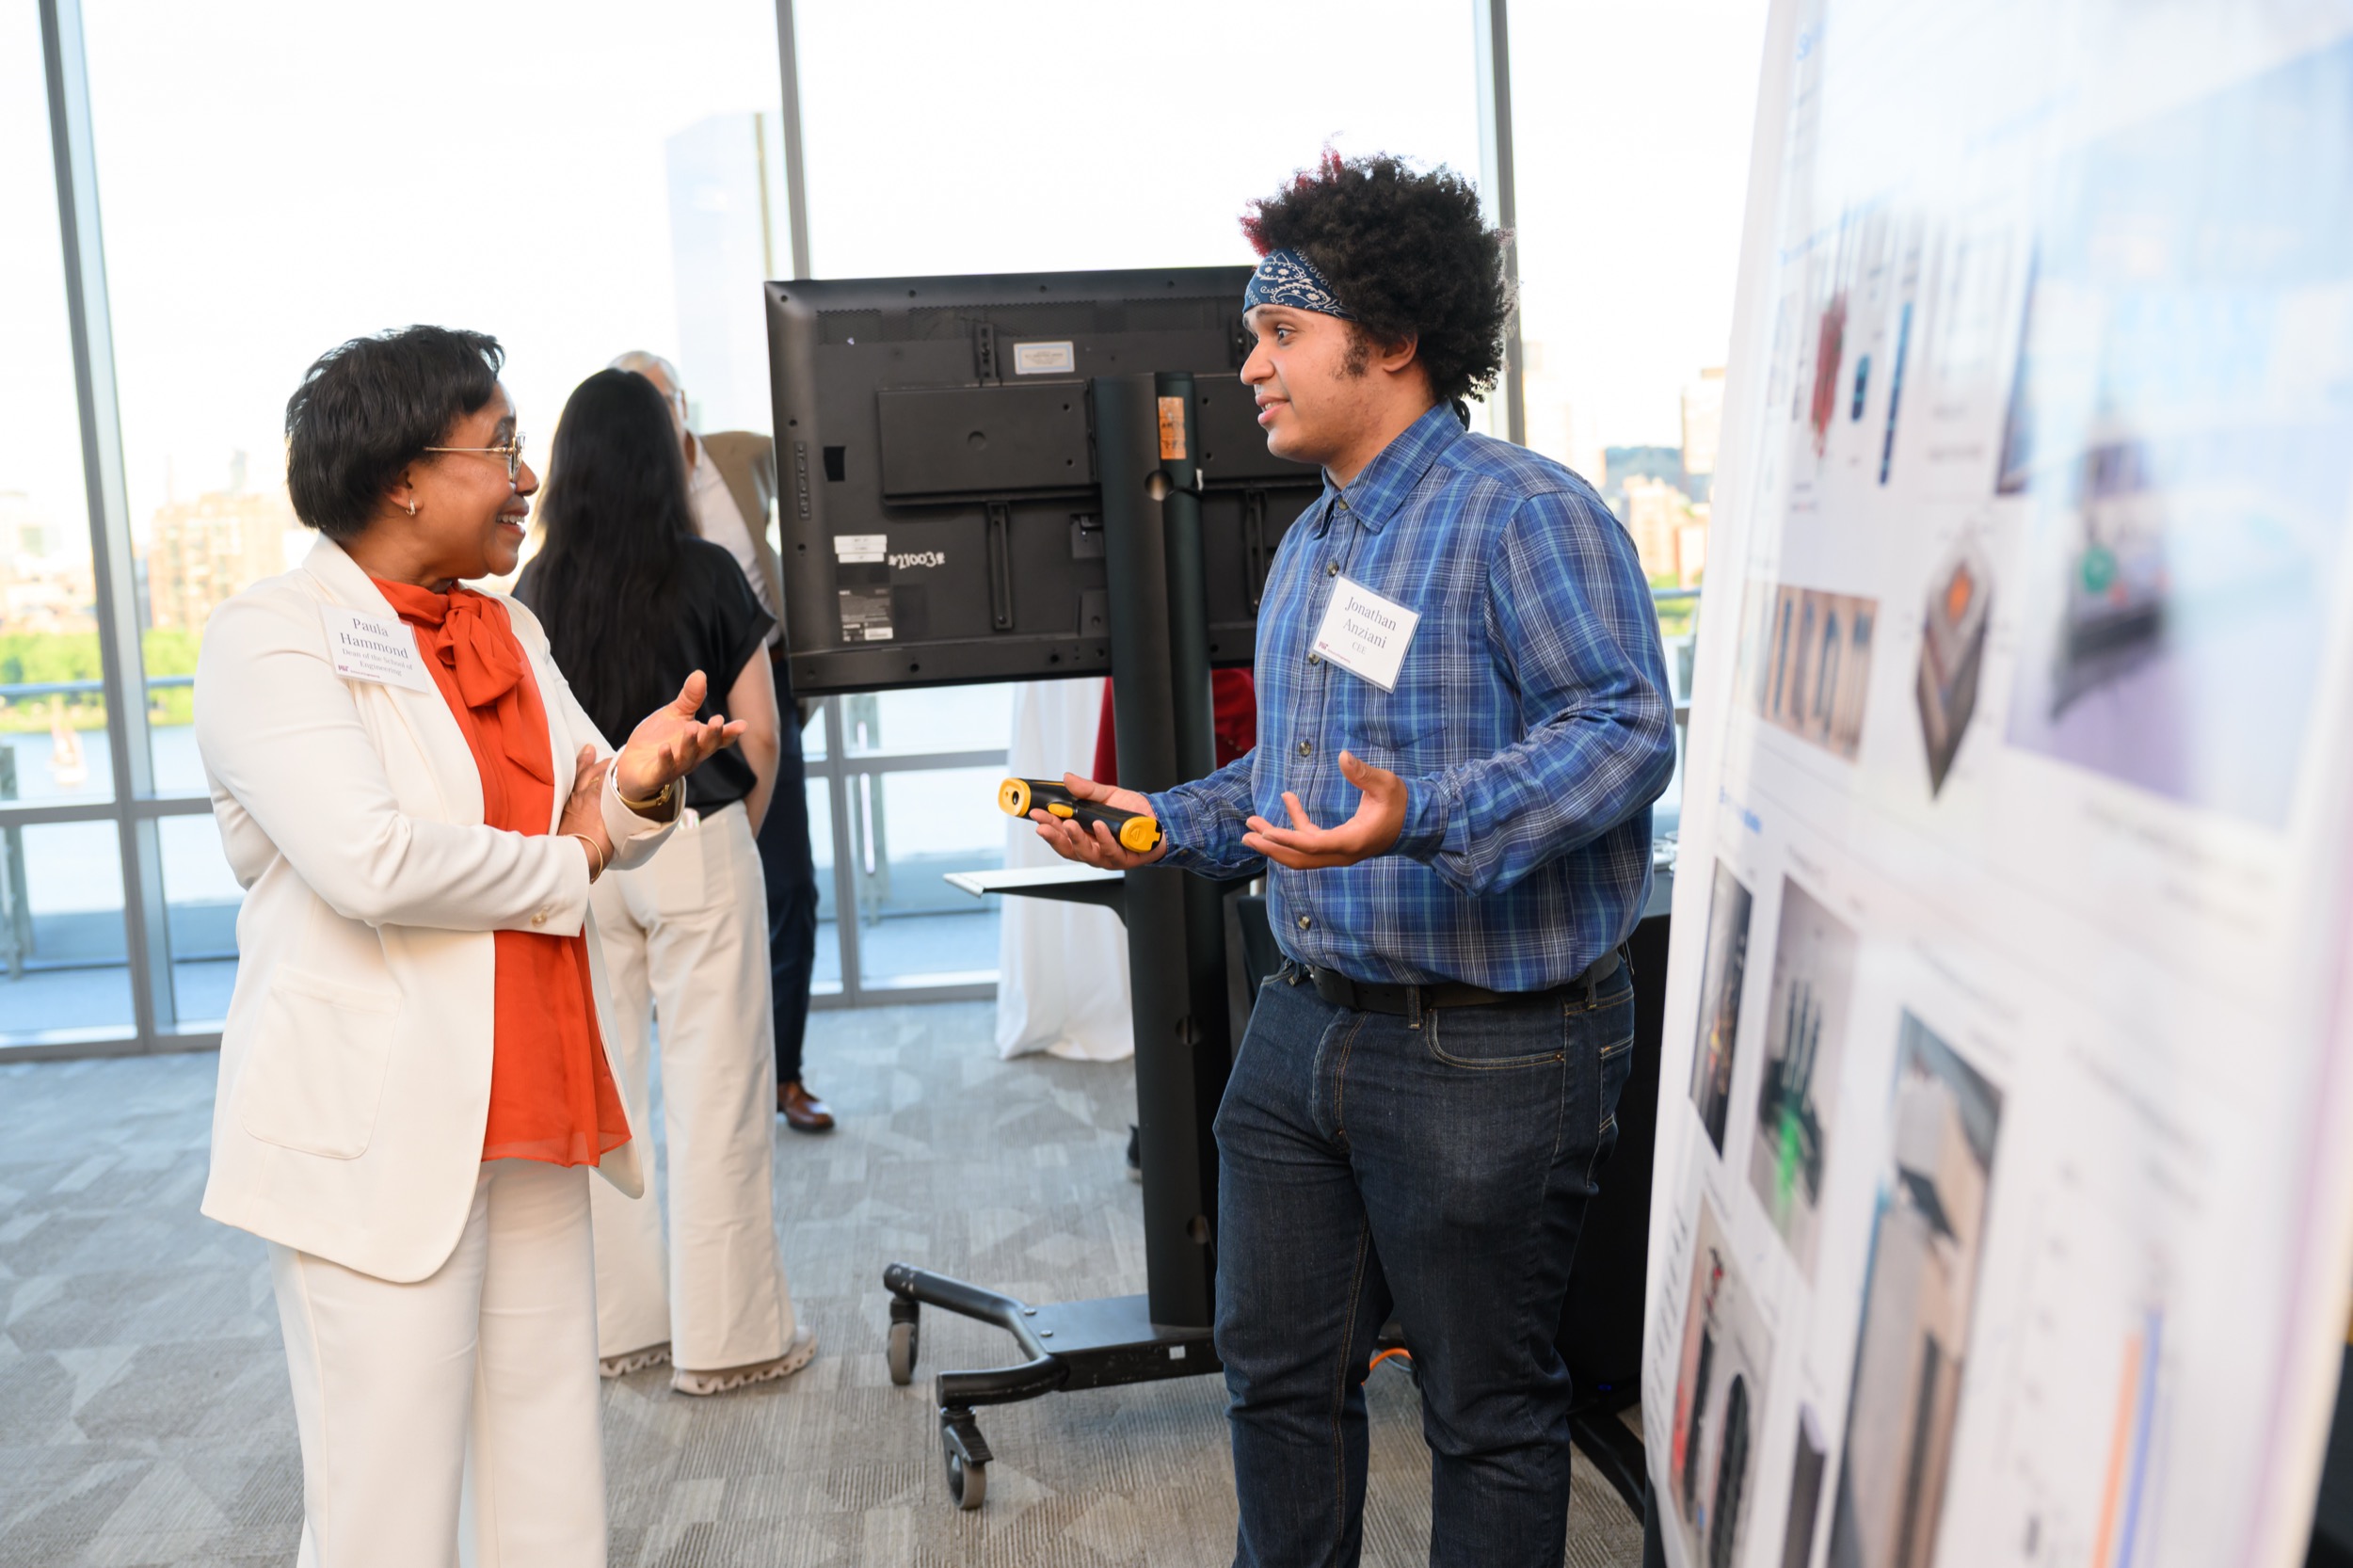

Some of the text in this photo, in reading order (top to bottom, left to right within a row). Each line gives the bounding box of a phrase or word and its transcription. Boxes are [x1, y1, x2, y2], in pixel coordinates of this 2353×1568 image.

[353, 617, 389, 637] Paula
[1345, 597, 1397, 631] Jonathan
[340, 632, 408, 659] Hammond
[1343, 618, 1387, 648] Anziani
